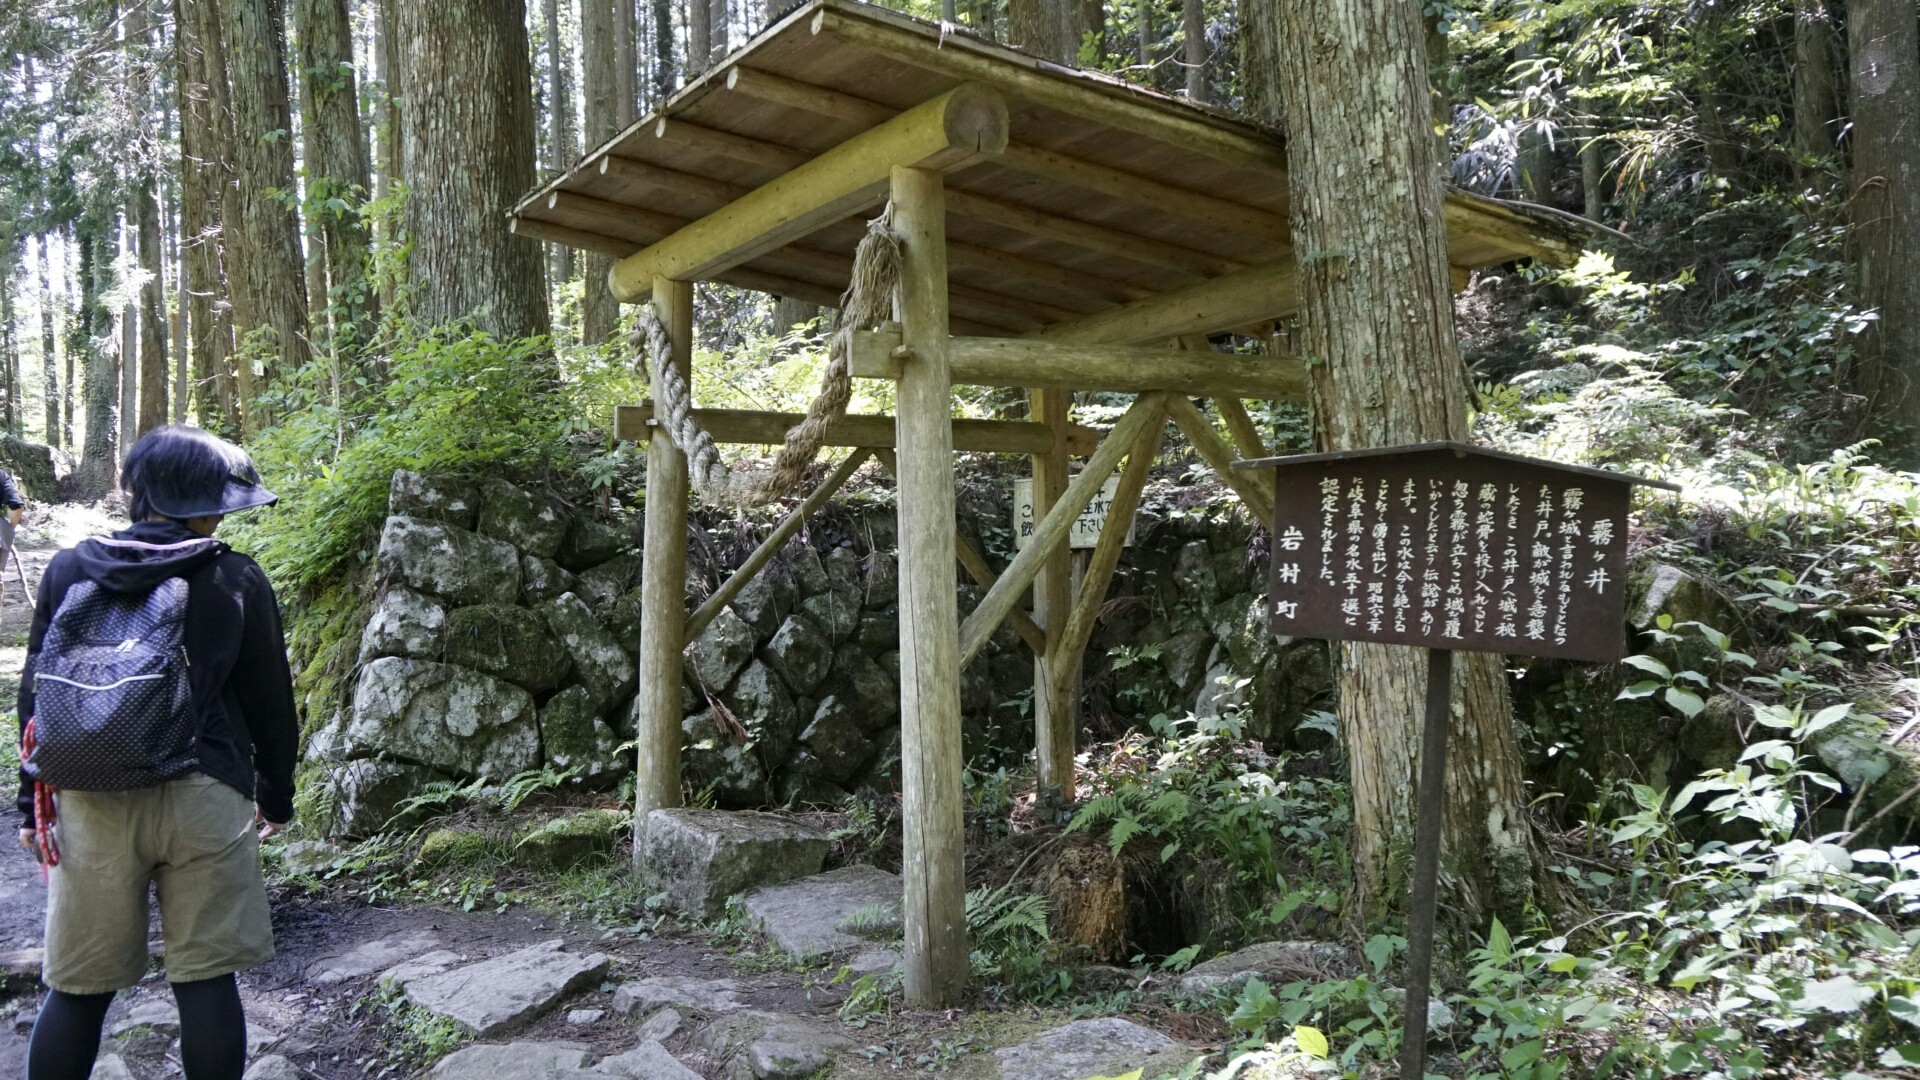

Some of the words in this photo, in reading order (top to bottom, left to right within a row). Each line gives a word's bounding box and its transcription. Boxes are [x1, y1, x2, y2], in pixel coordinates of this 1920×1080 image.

[1275, 525, 1305, 619] 岩村町
[1319, 477, 1341, 587] 認定されました。
[1341, 477, 1367, 626] に岐阜県の名水五十選に
[1441, 479, 1470, 640] 忽ち霧が立ちこめ城を覆
[1470, 483, 1498, 633] 蔵の蛇骨を投げ入れると
[1524, 484, 1554, 641] た井戸。敵が城を急襲
[1584, 518, 1615, 595] 霧ヶ井
